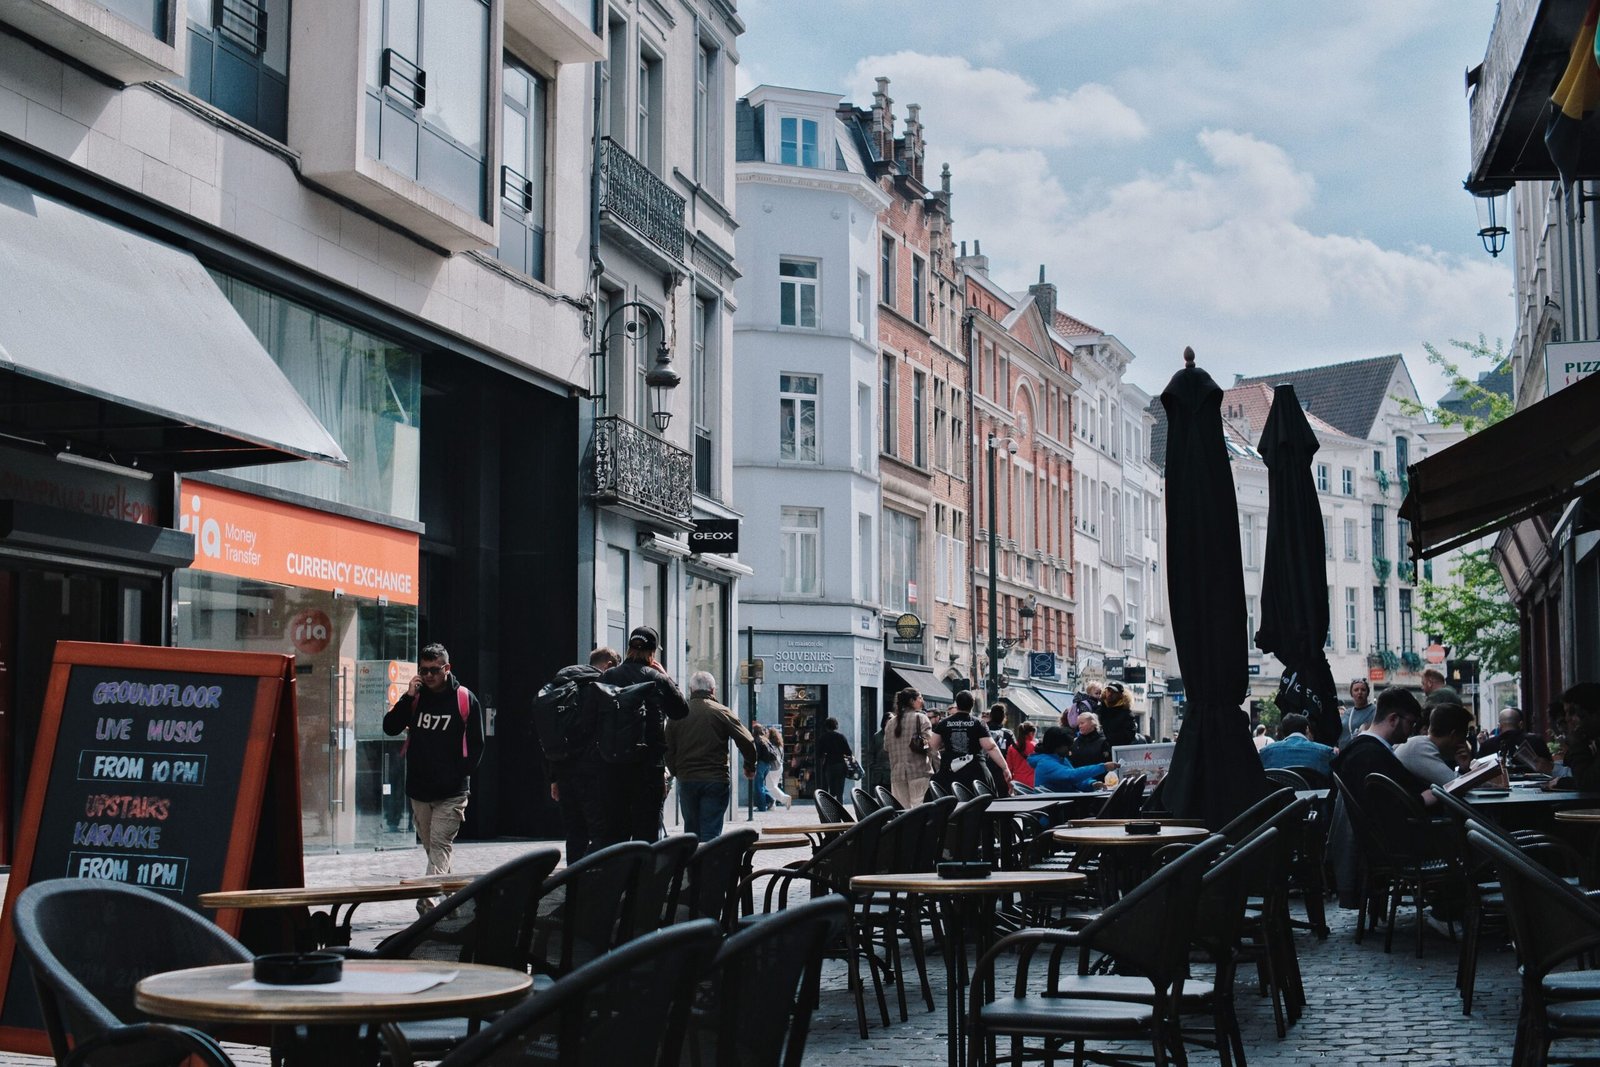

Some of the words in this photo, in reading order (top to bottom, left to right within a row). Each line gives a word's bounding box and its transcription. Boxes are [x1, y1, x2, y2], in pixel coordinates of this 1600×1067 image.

[225, 522, 257, 549] Money
[693, 532, 733, 540] GEOX
[225, 544, 261, 567] Transfer
[287, 552, 353, 584] CURRENCY
[354, 564, 412, 594] EXCHANGE
[295, 617, 326, 640] ria
[773, 662, 835, 673] CHOCOLATS
[776, 651, 831, 661] SOUVENIRS
[93, 681, 222, 708] GROUNDFLOOR
[95, 717, 133, 741] LIVE
[147, 720, 204, 743] MUSIC
[417, 711, 452, 731] 1977
[93, 755, 144, 779] FROM
[85, 794, 171, 820] UPSTAIRS
[73, 821, 161, 849] KARAOKE
[78, 857, 128, 881] FROM
